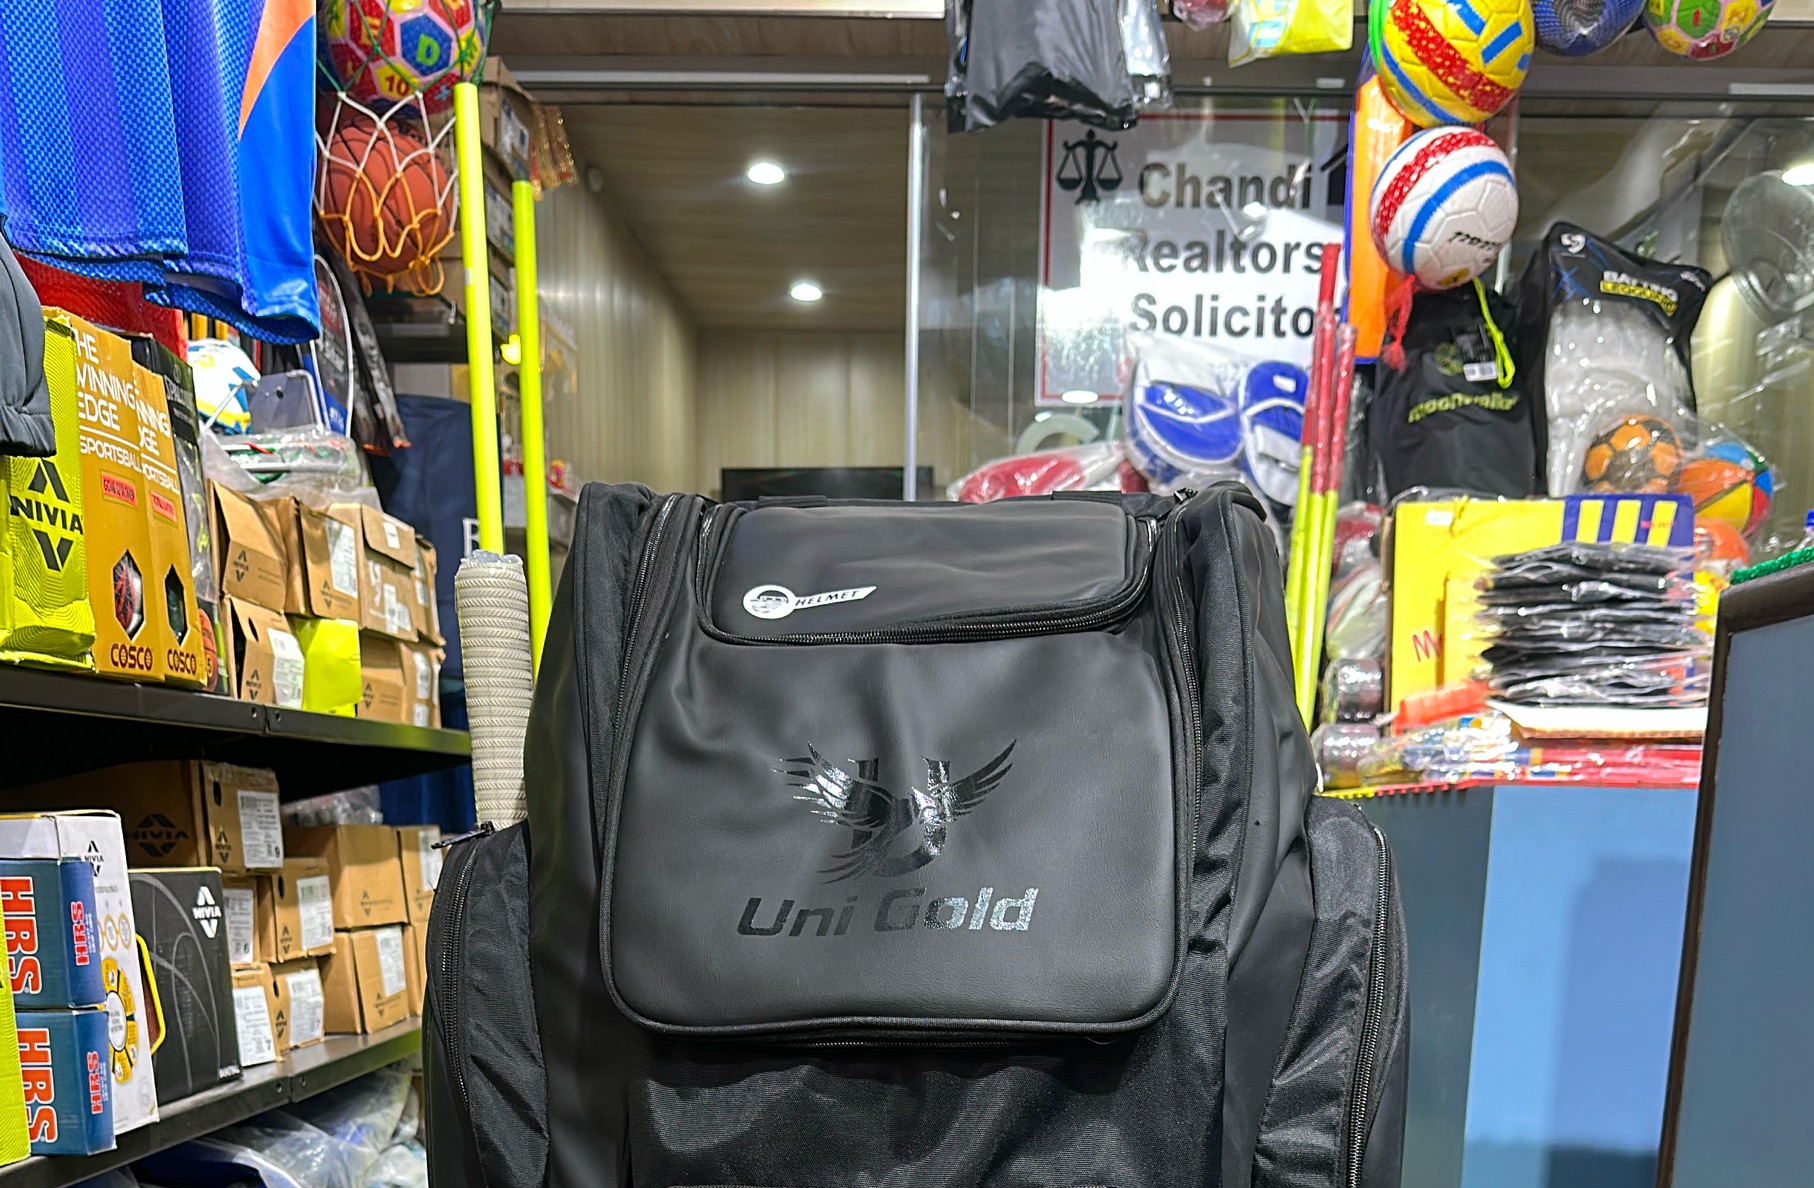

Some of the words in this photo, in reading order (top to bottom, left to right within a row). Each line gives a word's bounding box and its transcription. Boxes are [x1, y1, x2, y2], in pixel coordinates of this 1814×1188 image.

[1139, 162, 1312, 209] Chandi
[1130, 292, 1317, 338] Solicito
[9, 494, 84, 536] NIVIA
[795, 590, 860, 607] HELMET
[110, 643, 154, 671] COSCO
[167, 649, 197, 676] COSCO
[71, 901, 91, 966] HRS
[192, 903, 222, 921] NIVIA
[736, 894, 859, 938] Uni
[873, 886, 1039, 933] Gold
[0, 876, 42, 995] HRS
[17, 1028, 59, 1144] HRS
[87, 1051, 104, 1115] HRS
